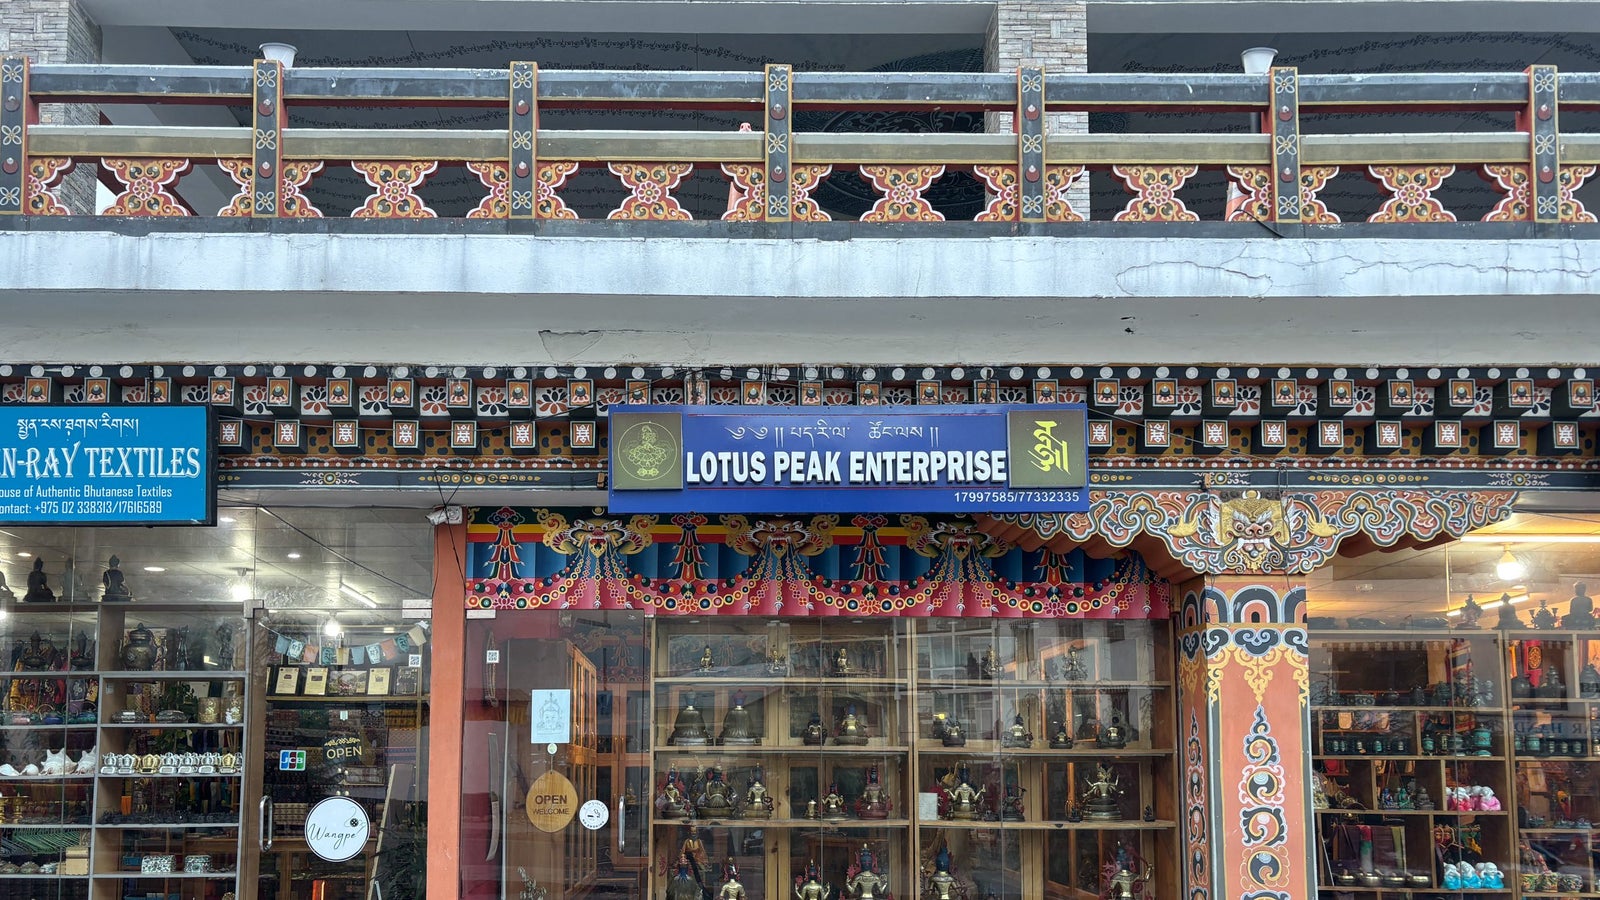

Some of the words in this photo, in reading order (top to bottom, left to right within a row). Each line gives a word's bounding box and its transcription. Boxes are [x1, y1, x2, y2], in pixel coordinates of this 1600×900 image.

[0, 440, 80, 480] N-RAY
[84, 446, 201, 479] TEXTILES
[686, 452, 766, 483] LOTUS
[774, 451, 841, 483] PEAK
[850, 450, 1007, 483] ENTERPRISE
[0, 487, 20, 498] ouse
[23, 485, 34, 498] of
[36, 485, 81, 498] Authentic
[84, 485, 134, 497] Bhutanese
[137, 485, 173, 497] Textiles
[954, 491, 1080, 503] 17997585/77332335
[0, 502, 32, 514] ontact:
[34, 502, 59, 514] +975
[61, 502, 75, 514] 02
[77, 501, 163, 514] 338313/17616589
[326, 745, 362, 760] OPEN
[535, 794, 567, 805] OPEN
[533, 807, 570, 815] WELCOME
[307, 823, 357, 851] Wangpe
